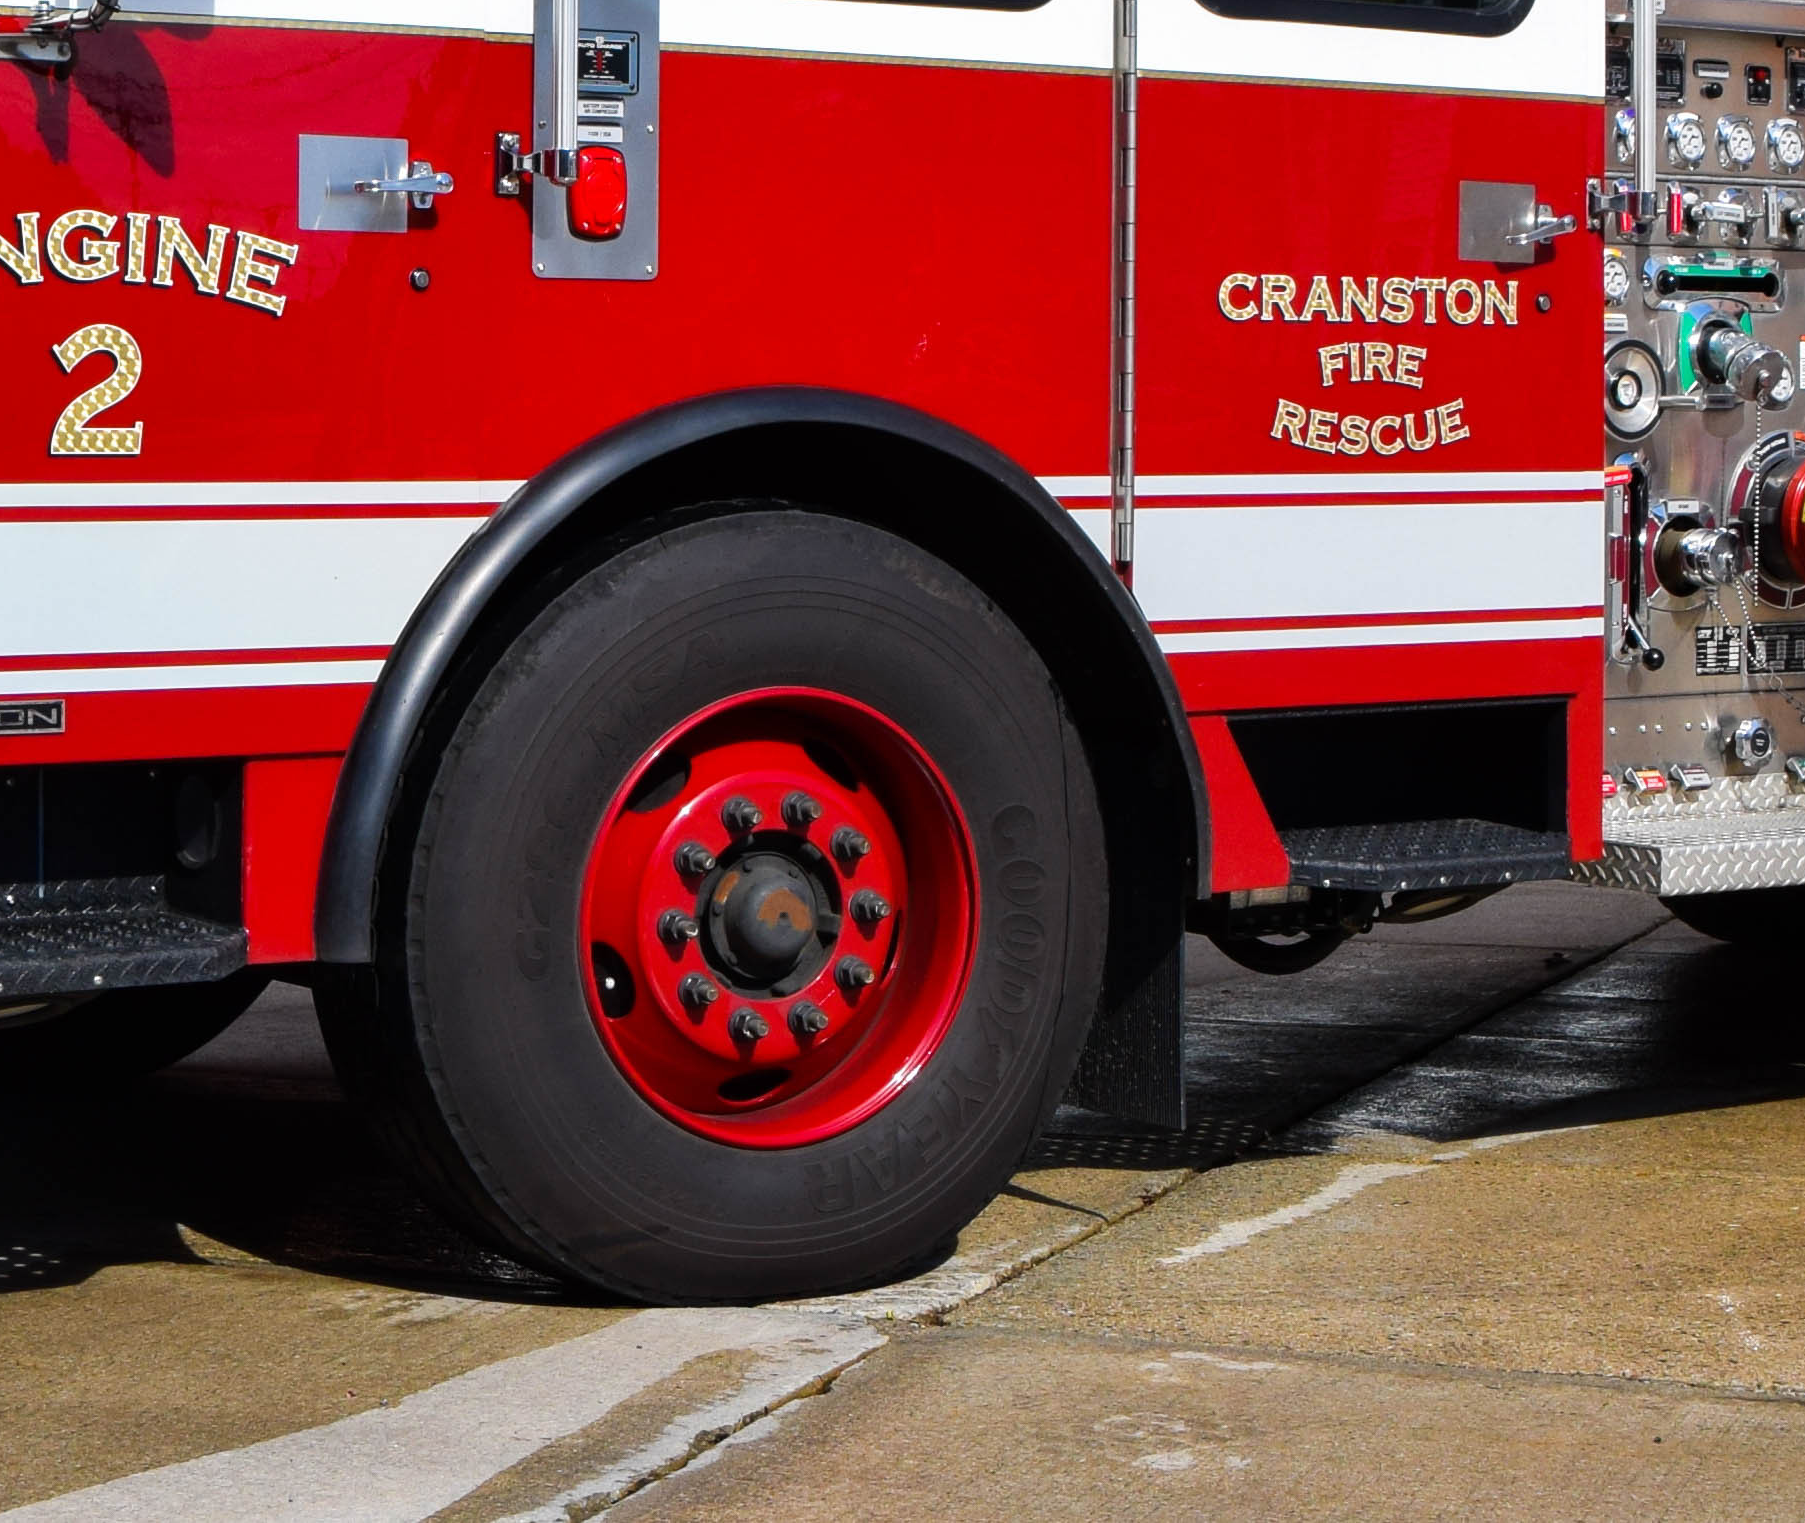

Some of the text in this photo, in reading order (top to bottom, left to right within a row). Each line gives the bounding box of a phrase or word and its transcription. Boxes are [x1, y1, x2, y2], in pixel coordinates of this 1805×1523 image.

[1218, 273, 1519, 325] CRANSTON
[49, 324, 144, 457] 2
[1318, 341, 1428, 389] FIRE
[1270, 398, 1471, 456] RESCUE
